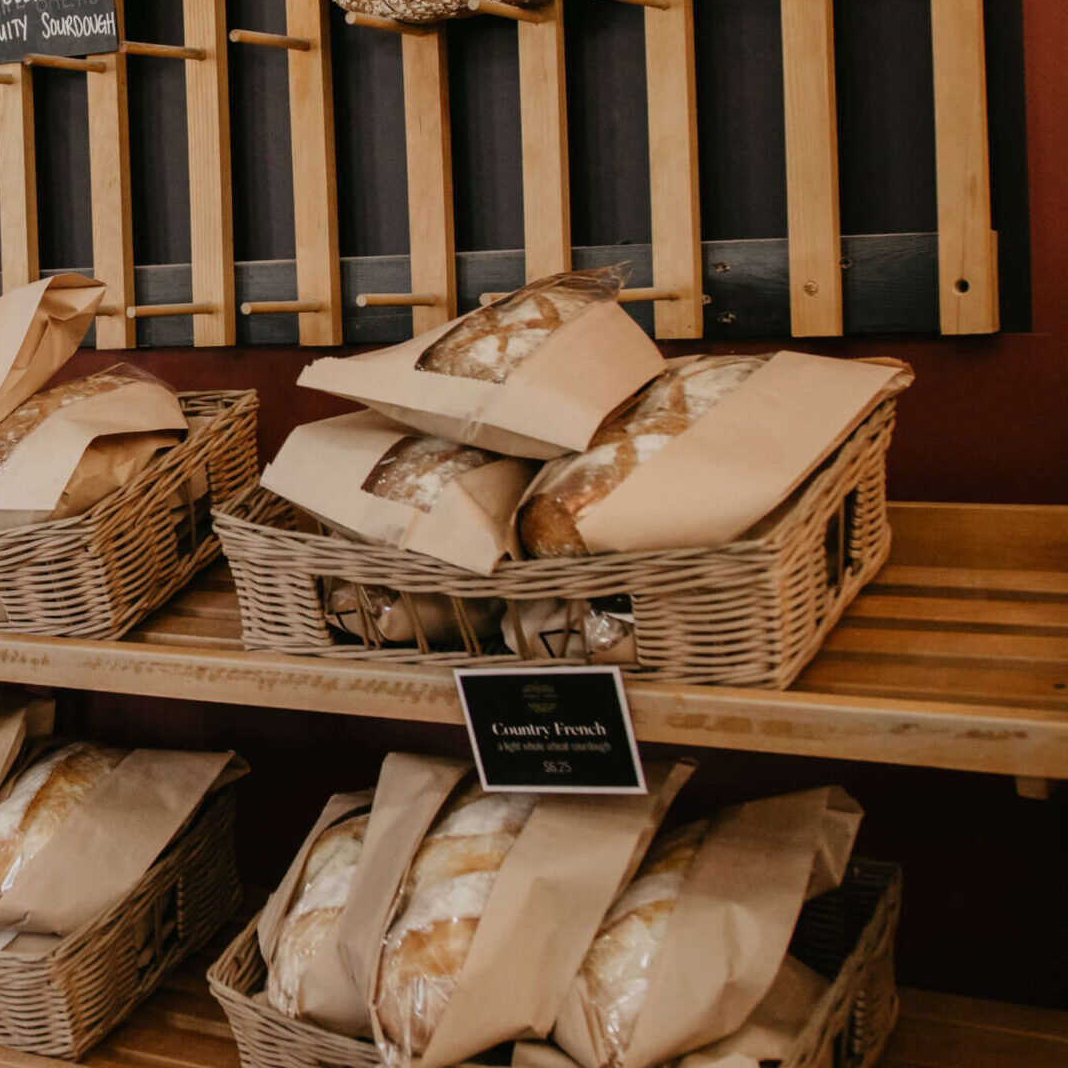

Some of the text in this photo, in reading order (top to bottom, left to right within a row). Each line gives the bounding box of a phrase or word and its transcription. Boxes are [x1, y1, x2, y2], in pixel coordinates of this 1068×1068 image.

[41, 11, 116, 39] SOURDOUGH
[492, 721, 607, 739] Country French
